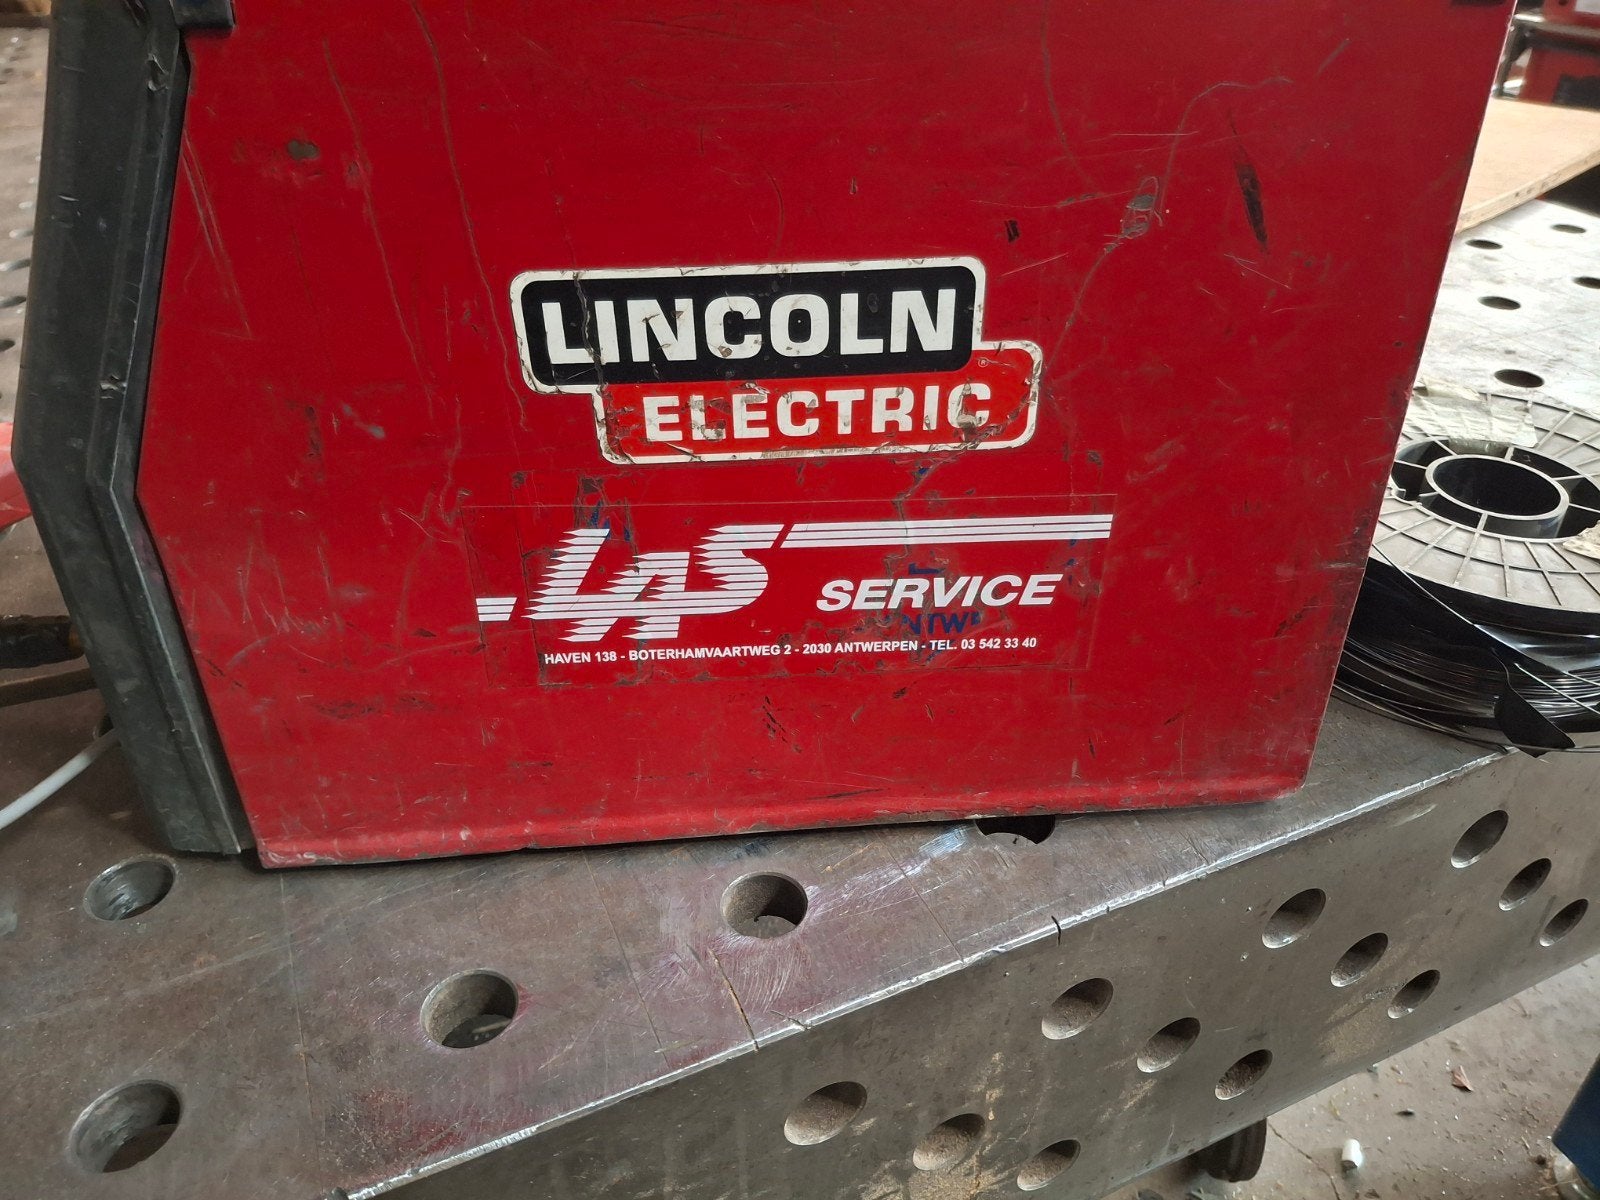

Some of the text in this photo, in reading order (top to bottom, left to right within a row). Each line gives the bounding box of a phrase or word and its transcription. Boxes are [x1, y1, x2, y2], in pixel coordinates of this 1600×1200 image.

[541, 288, 957, 365] LINCOLN
[642, 382, 992, 442] ELECTRIC
[816, 573, 1063, 612] SERVICE
[543, 651, 592, 665] HAVEN
[594, 650, 618, 663] 138
[628, 644, 781, 661] BOTERHAMVAARTWEG
[783, 644, 792, 655] 2
[802, 642, 833, 655] 2030
[834, 639, 919, 654] ANTWERPEN
[928, 638, 958, 651] TEL.
[960, 638, 976, 650] 03
[978, 637, 1001, 650] 542
[1003, 637, 1019, 649] 33
[1021, 637, 1037, 648] 40
